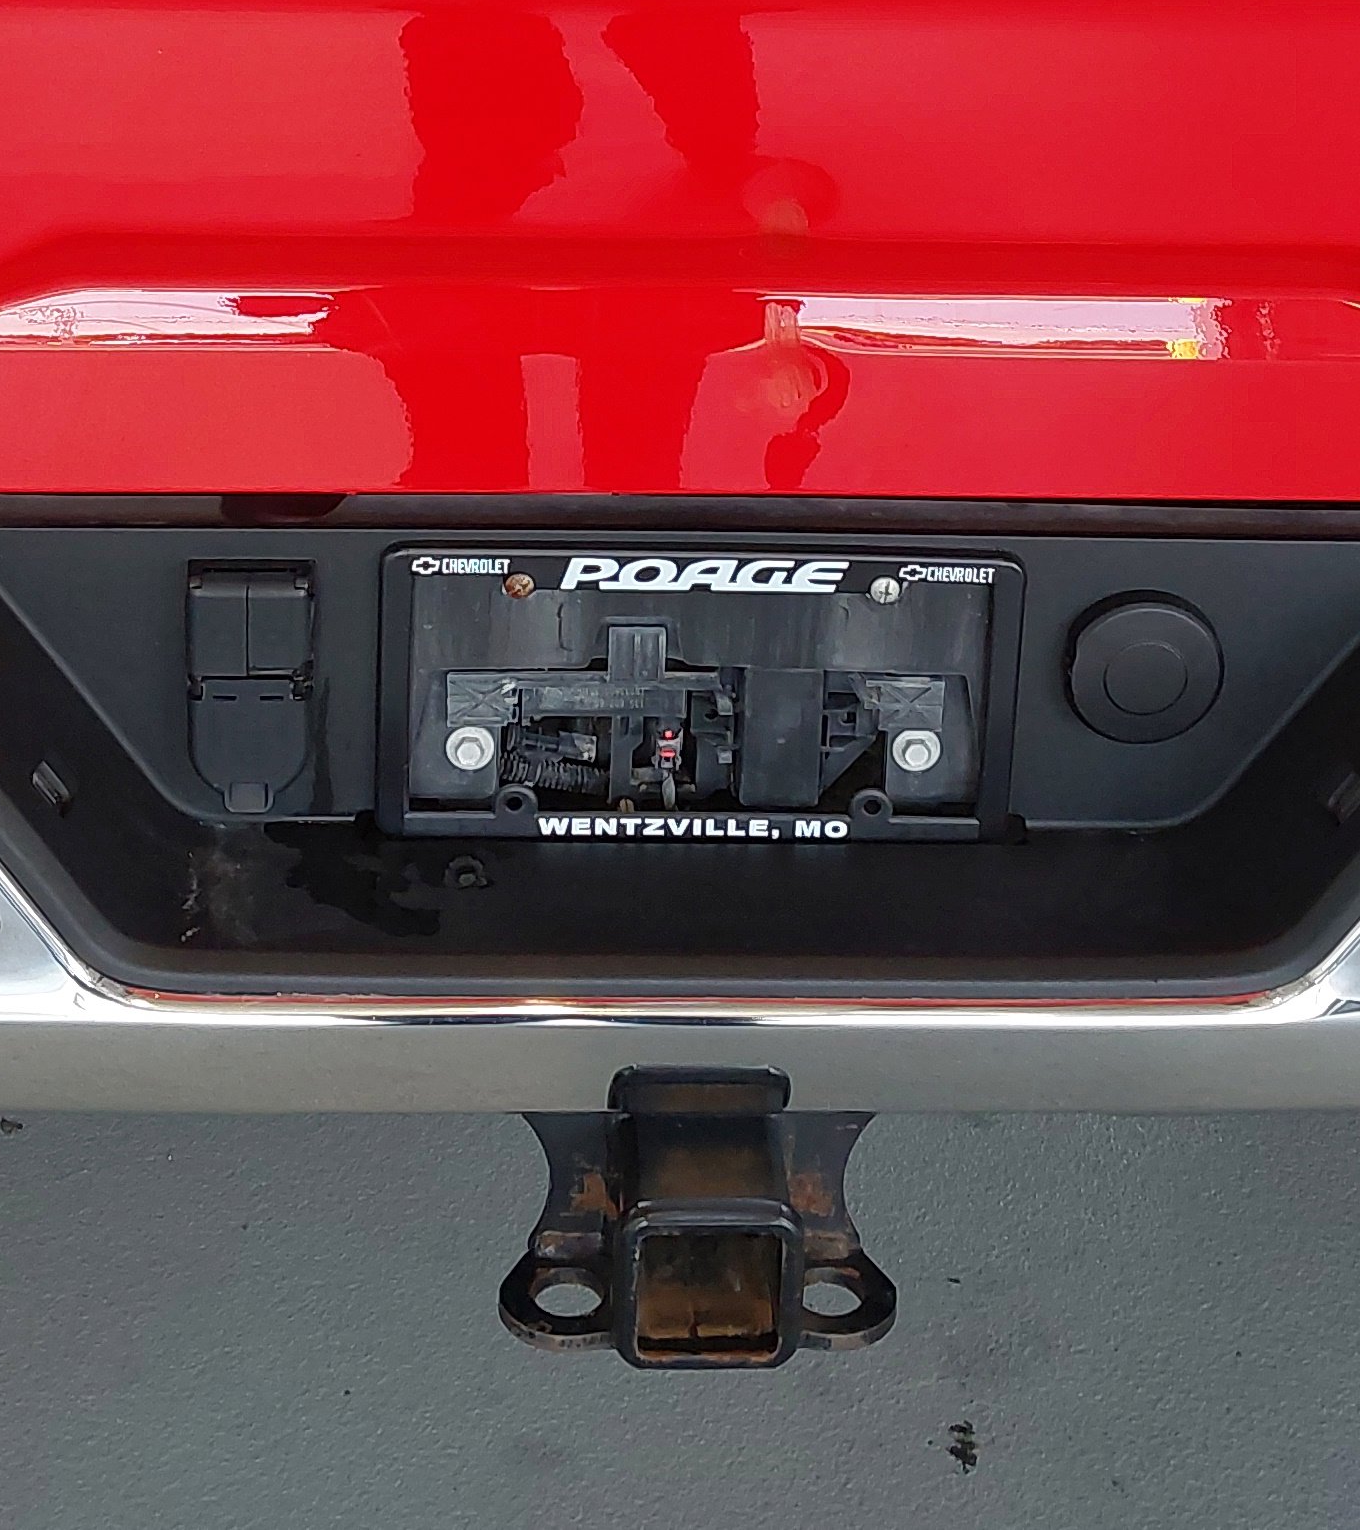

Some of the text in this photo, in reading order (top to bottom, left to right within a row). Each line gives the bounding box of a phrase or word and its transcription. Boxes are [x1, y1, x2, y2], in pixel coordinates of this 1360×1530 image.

[442, 558, 511, 575] CHEVROLET
[559, 557, 850, 592] POAGE
[926, 566, 996, 584] CHEVROLET
[538, 817, 848, 839] WENTZVILLE, MO
